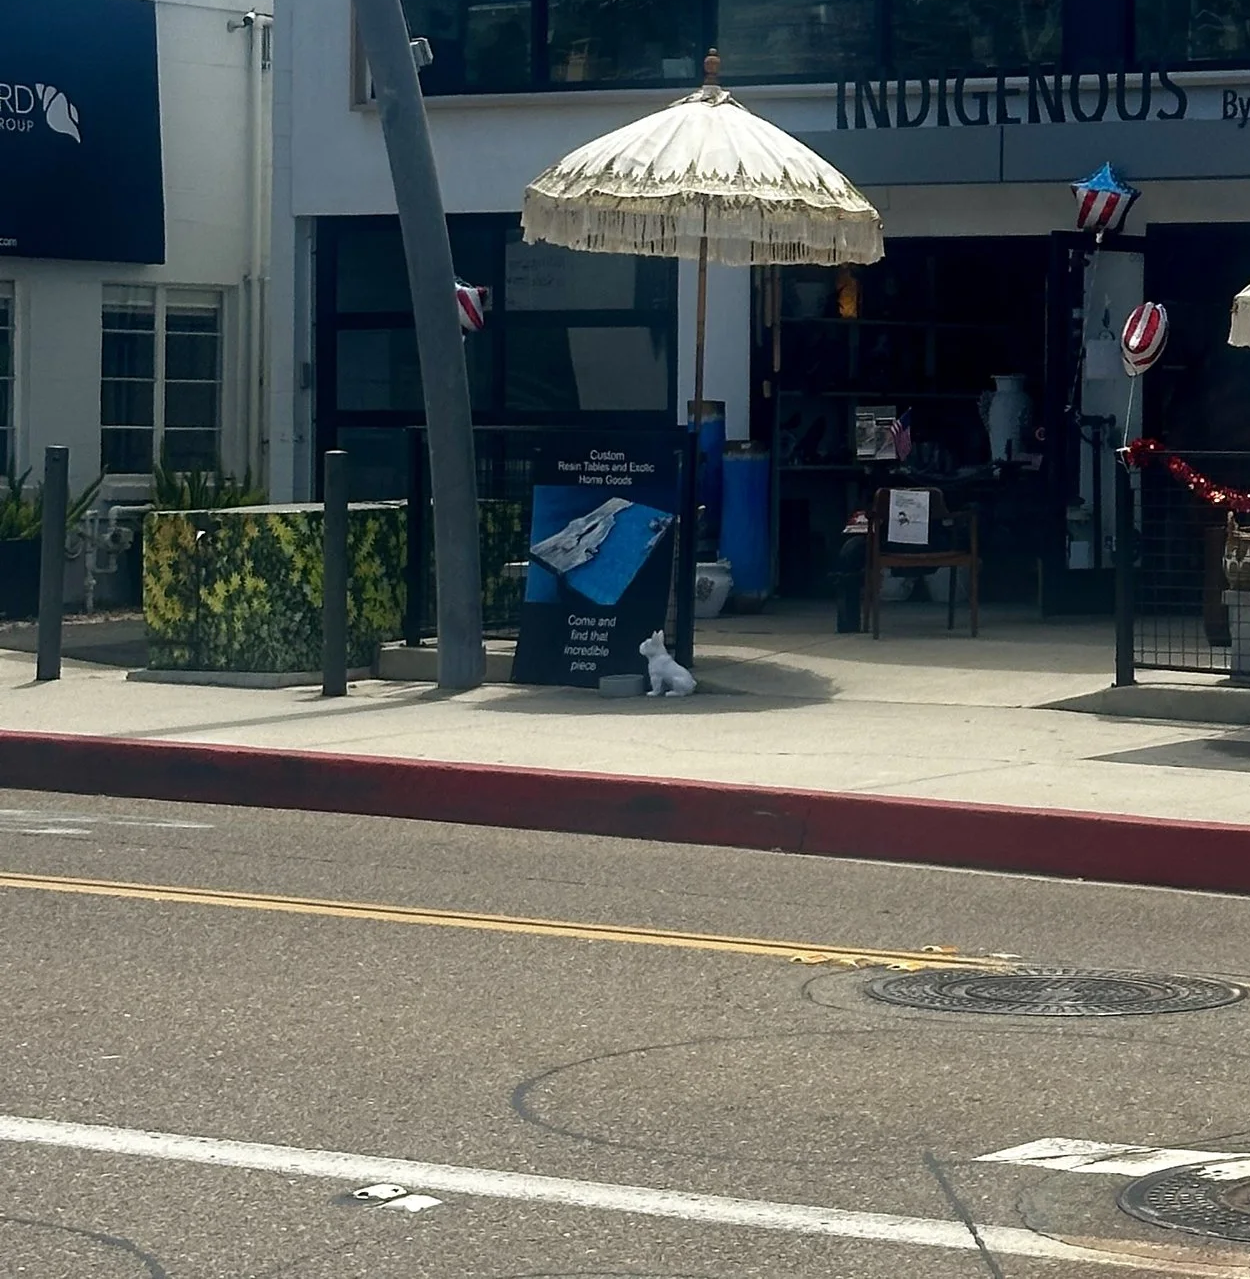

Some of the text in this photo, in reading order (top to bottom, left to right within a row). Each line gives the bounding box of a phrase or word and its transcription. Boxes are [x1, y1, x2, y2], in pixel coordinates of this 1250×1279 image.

[0, 83, 35, 114] RD
[836, 62, 1188, 129] INDIGENOUS
[590, 449, 625, 461] Custom
[558, 461, 655, 473] Resin Tables and Exotic
[579, 474, 633, 486] Home Goods
[568, 614, 617, 627] Come and
[570, 628, 609, 642] find that
[563, 644, 610, 657] incredible
[570, 660, 597, 673] piece
